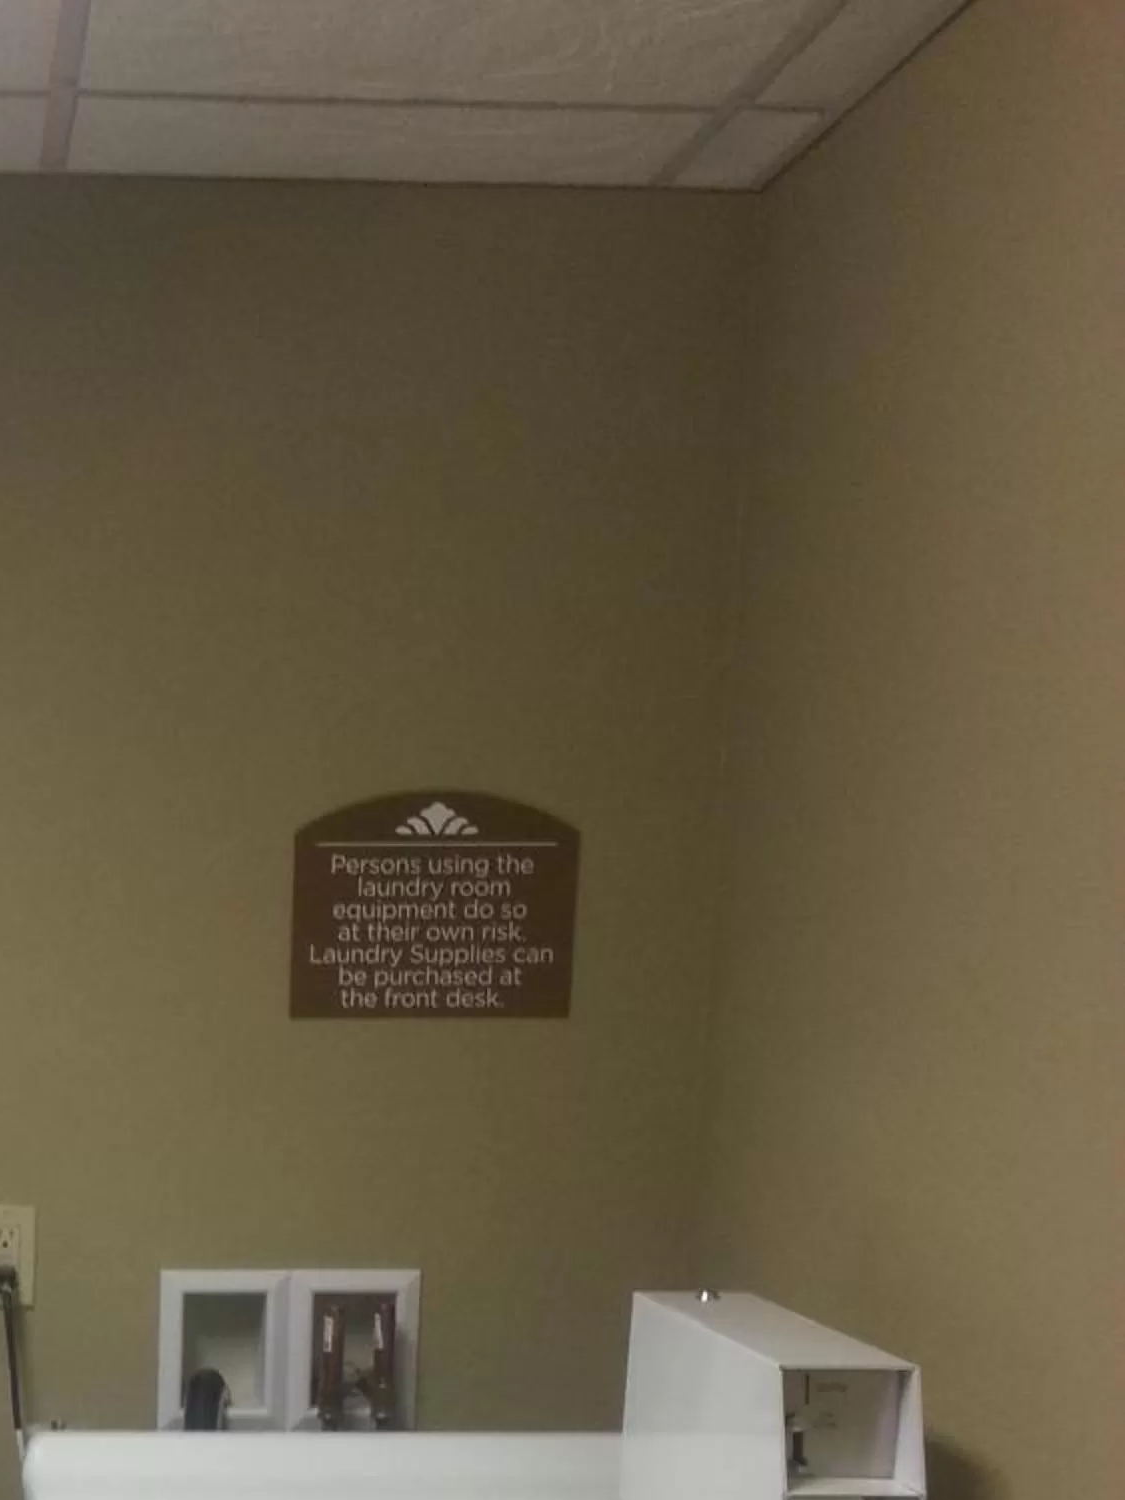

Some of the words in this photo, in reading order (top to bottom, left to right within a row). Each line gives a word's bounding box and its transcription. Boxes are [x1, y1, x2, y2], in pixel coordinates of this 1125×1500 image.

[331, 854, 421, 875] Persons
[428, 855, 490, 878] using
[497, 854, 534, 875] the
[358, 876, 443, 900] laundry
[450, 880, 511, 897] room
[332, 901, 456, 923] equipment
[464, 900, 493, 920] do
[501, 903, 527, 920] so
[338, 923, 359, 941] at
[368, 923, 420, 941] their
[426, 925, 474, 941] own
[309, 944, 403, 967] Laundry
[410, 944, 505, 967] Supplies
[512, 947, 554, 963] can
[338, 967, 367, 986] be
[375, 967, 493, 989] purchased
[500, 967, 522, 986] at
[341, 988, 378, 1008] the
[384, 988, 440, 1009] front
[446, 988, 505, 1009] desk.
